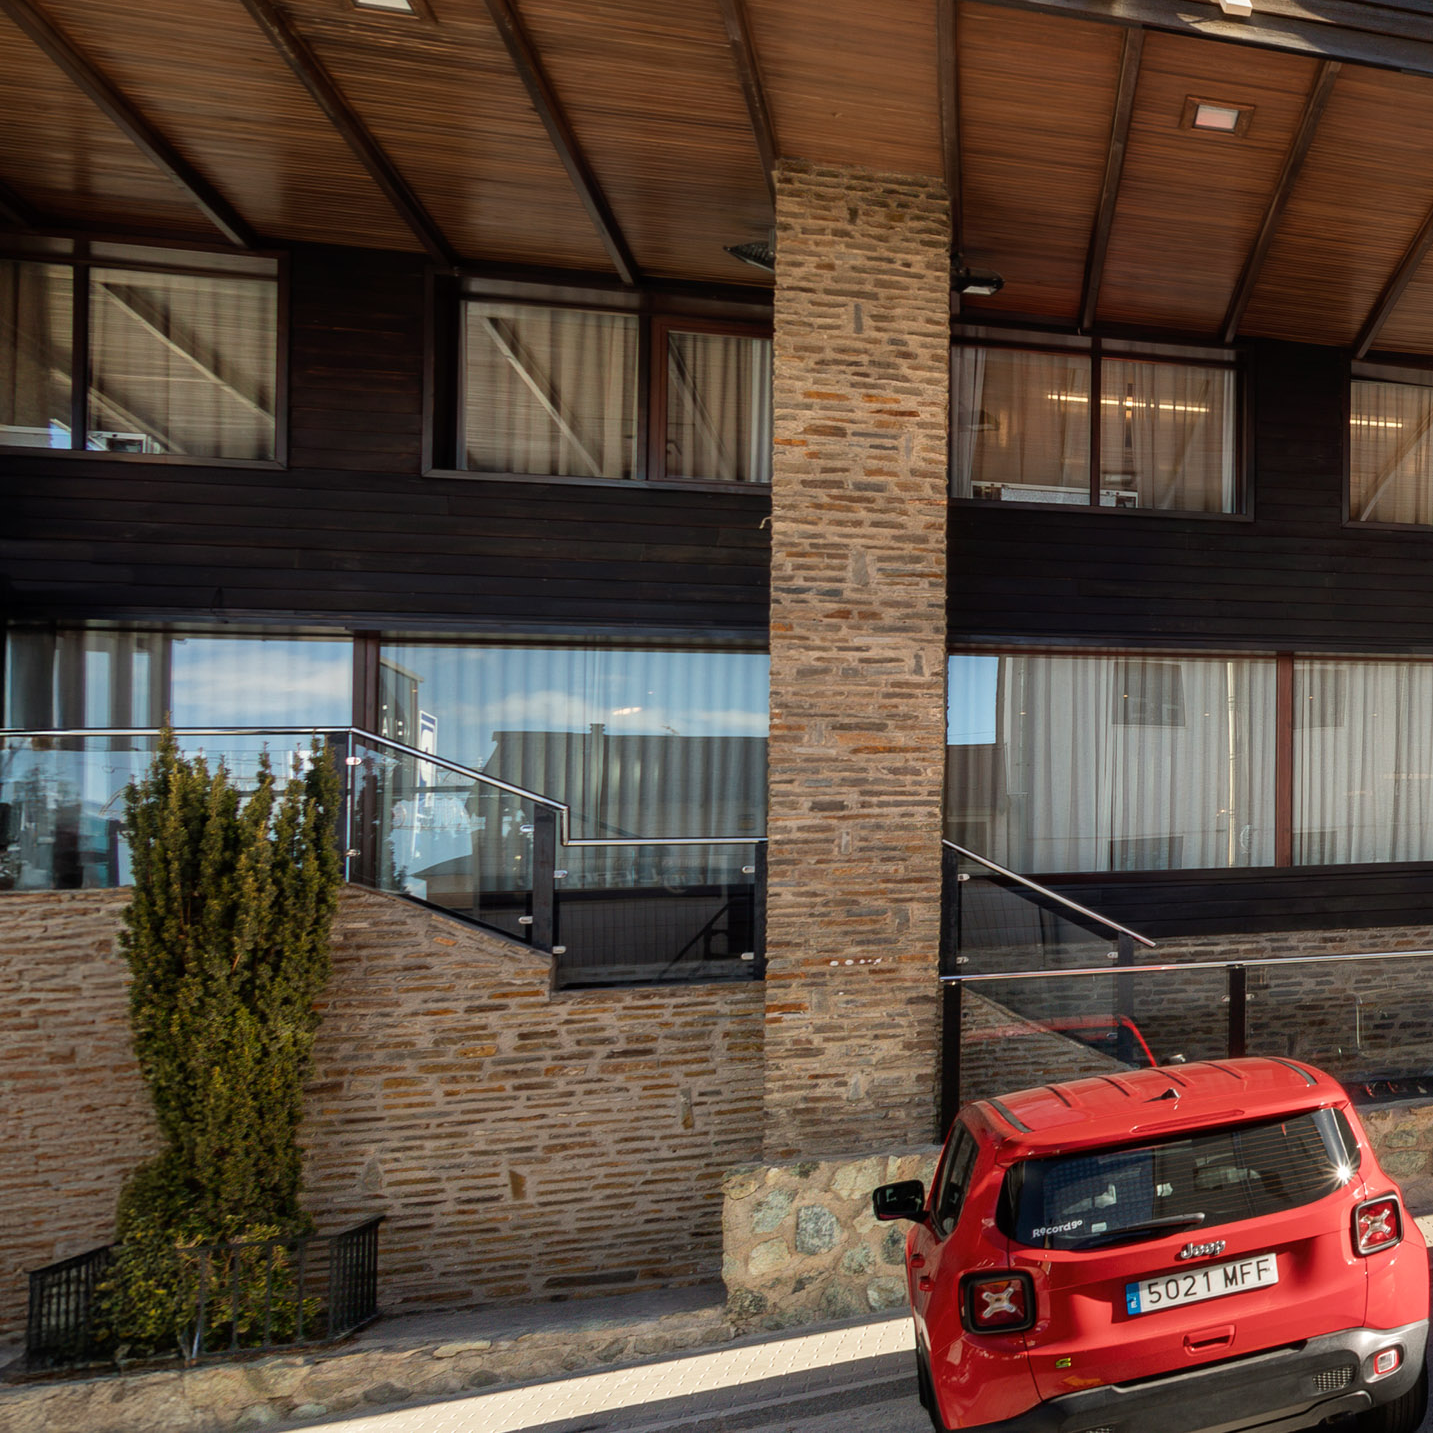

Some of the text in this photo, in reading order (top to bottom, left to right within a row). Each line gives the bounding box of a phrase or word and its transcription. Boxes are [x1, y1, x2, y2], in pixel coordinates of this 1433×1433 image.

[1179, 1240, 1226, 1260] Jeep
[1148, 1271, 1211, 1304] 5021
[1223, 1258, 1271, 1289] MFF
